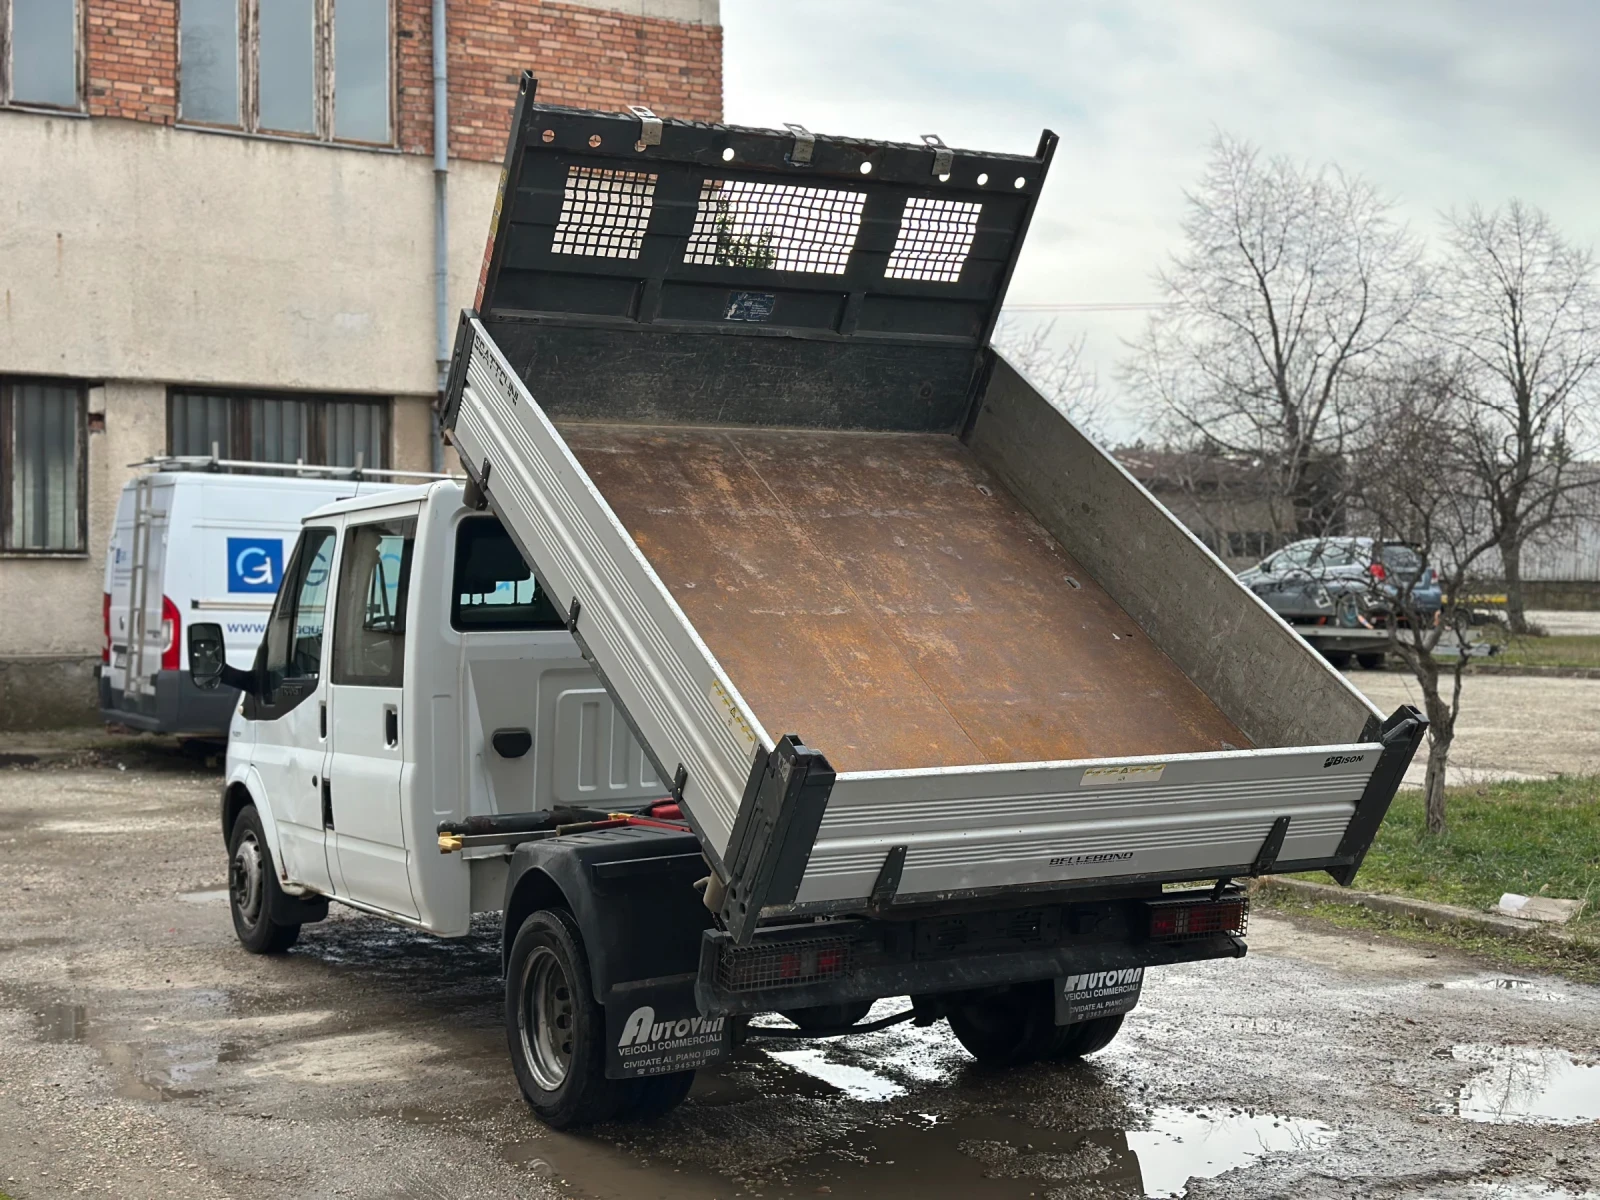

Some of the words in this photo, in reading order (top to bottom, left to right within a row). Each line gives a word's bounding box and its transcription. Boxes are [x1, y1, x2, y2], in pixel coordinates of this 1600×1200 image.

[1332, 755, 1364, 766] BISON
[1064, 992, 1092, 1001] VEICOLI
[1093, 984, 1139, 997] COMMERCIALI
[1105, 999, 1123, 1007] PIANO
[618, 1044, 656, 1056] VEICOLI
[658, 1033, 722, 1050] COMMERCIALI
[623, 1057, 662, 1069] CIVIDATE
[662, 1055, 673, 1064] AL
[675, 1051, 701, 1061] PIANO
[702, 1048, 720, 1058] (BG)
